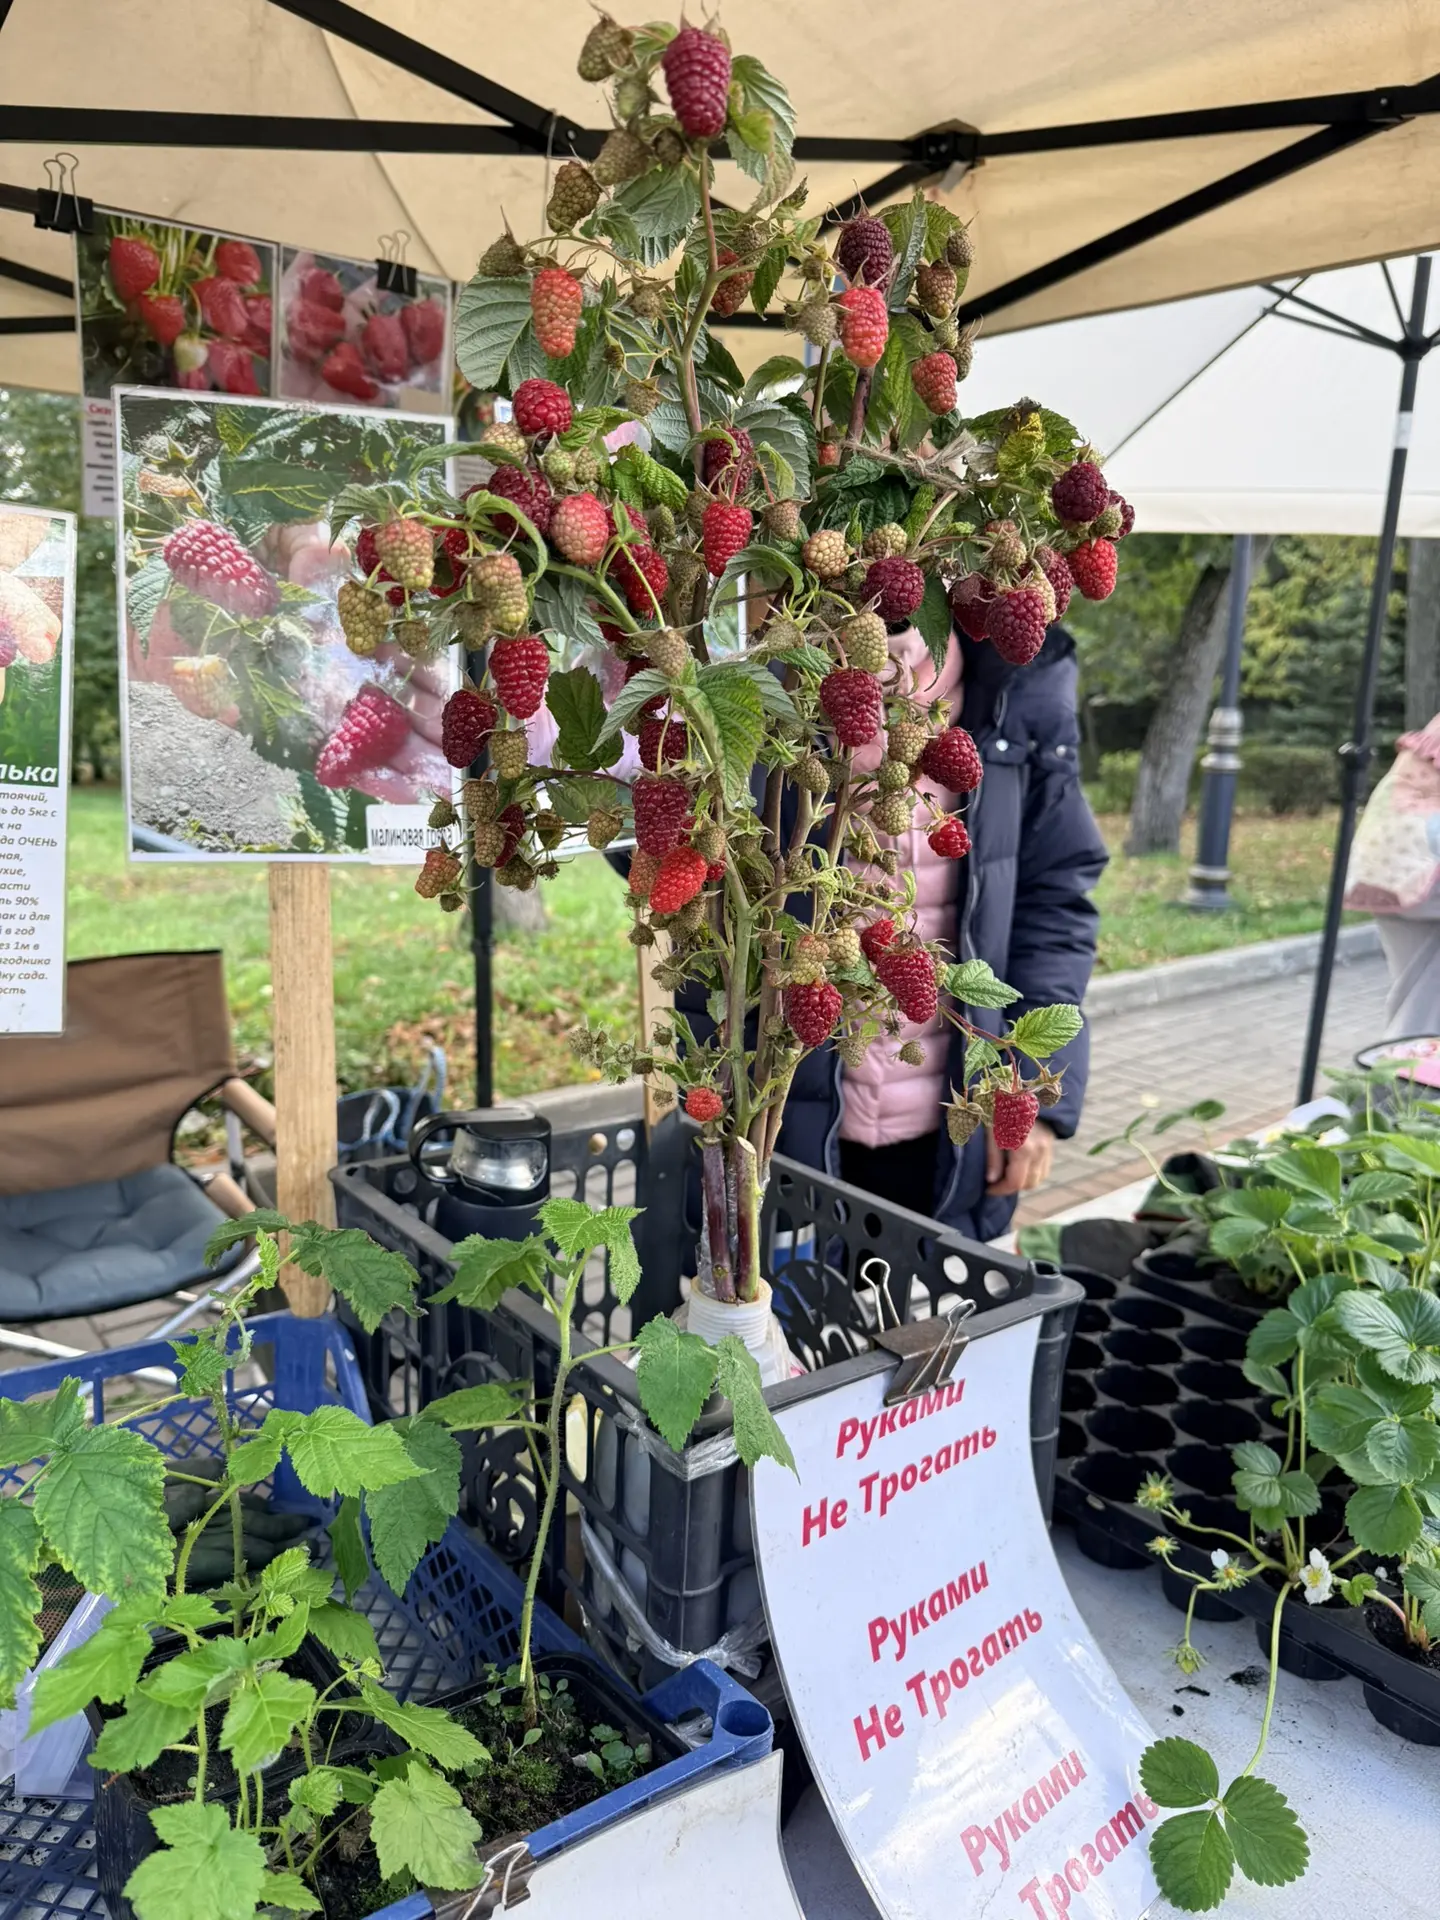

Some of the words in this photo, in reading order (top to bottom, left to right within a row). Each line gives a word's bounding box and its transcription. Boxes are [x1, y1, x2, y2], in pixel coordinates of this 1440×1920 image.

[11, 806, 25, 816] до
[28, 807, 48, 817] 5кг
[7, 823, 22, 831] на
[18, 836, 58, 847] ОЧЕНЬ
[15, 896, 39, 906] 90%
[29, 911, 51, 921] для
[5, 927, 12, 935] в
[14, 926, 35, 935] год
[13, 941, 30, 950] 1м
[18, 970, 48, 980] сада.
[836, 1378, 966, 1461] Руками
[802, 1497, 849, 1547] Не
[858, 1426, 998, 1518] Трогать
[867, 1561, 990, 1663] Руками
[853, 1704, 905, 1762] Не
[905, 1608, 1043, 1720] Трогать
[960, 1750, 1087, 1875] Руками
[1018, 1792, 1160, 1920] Трогать
